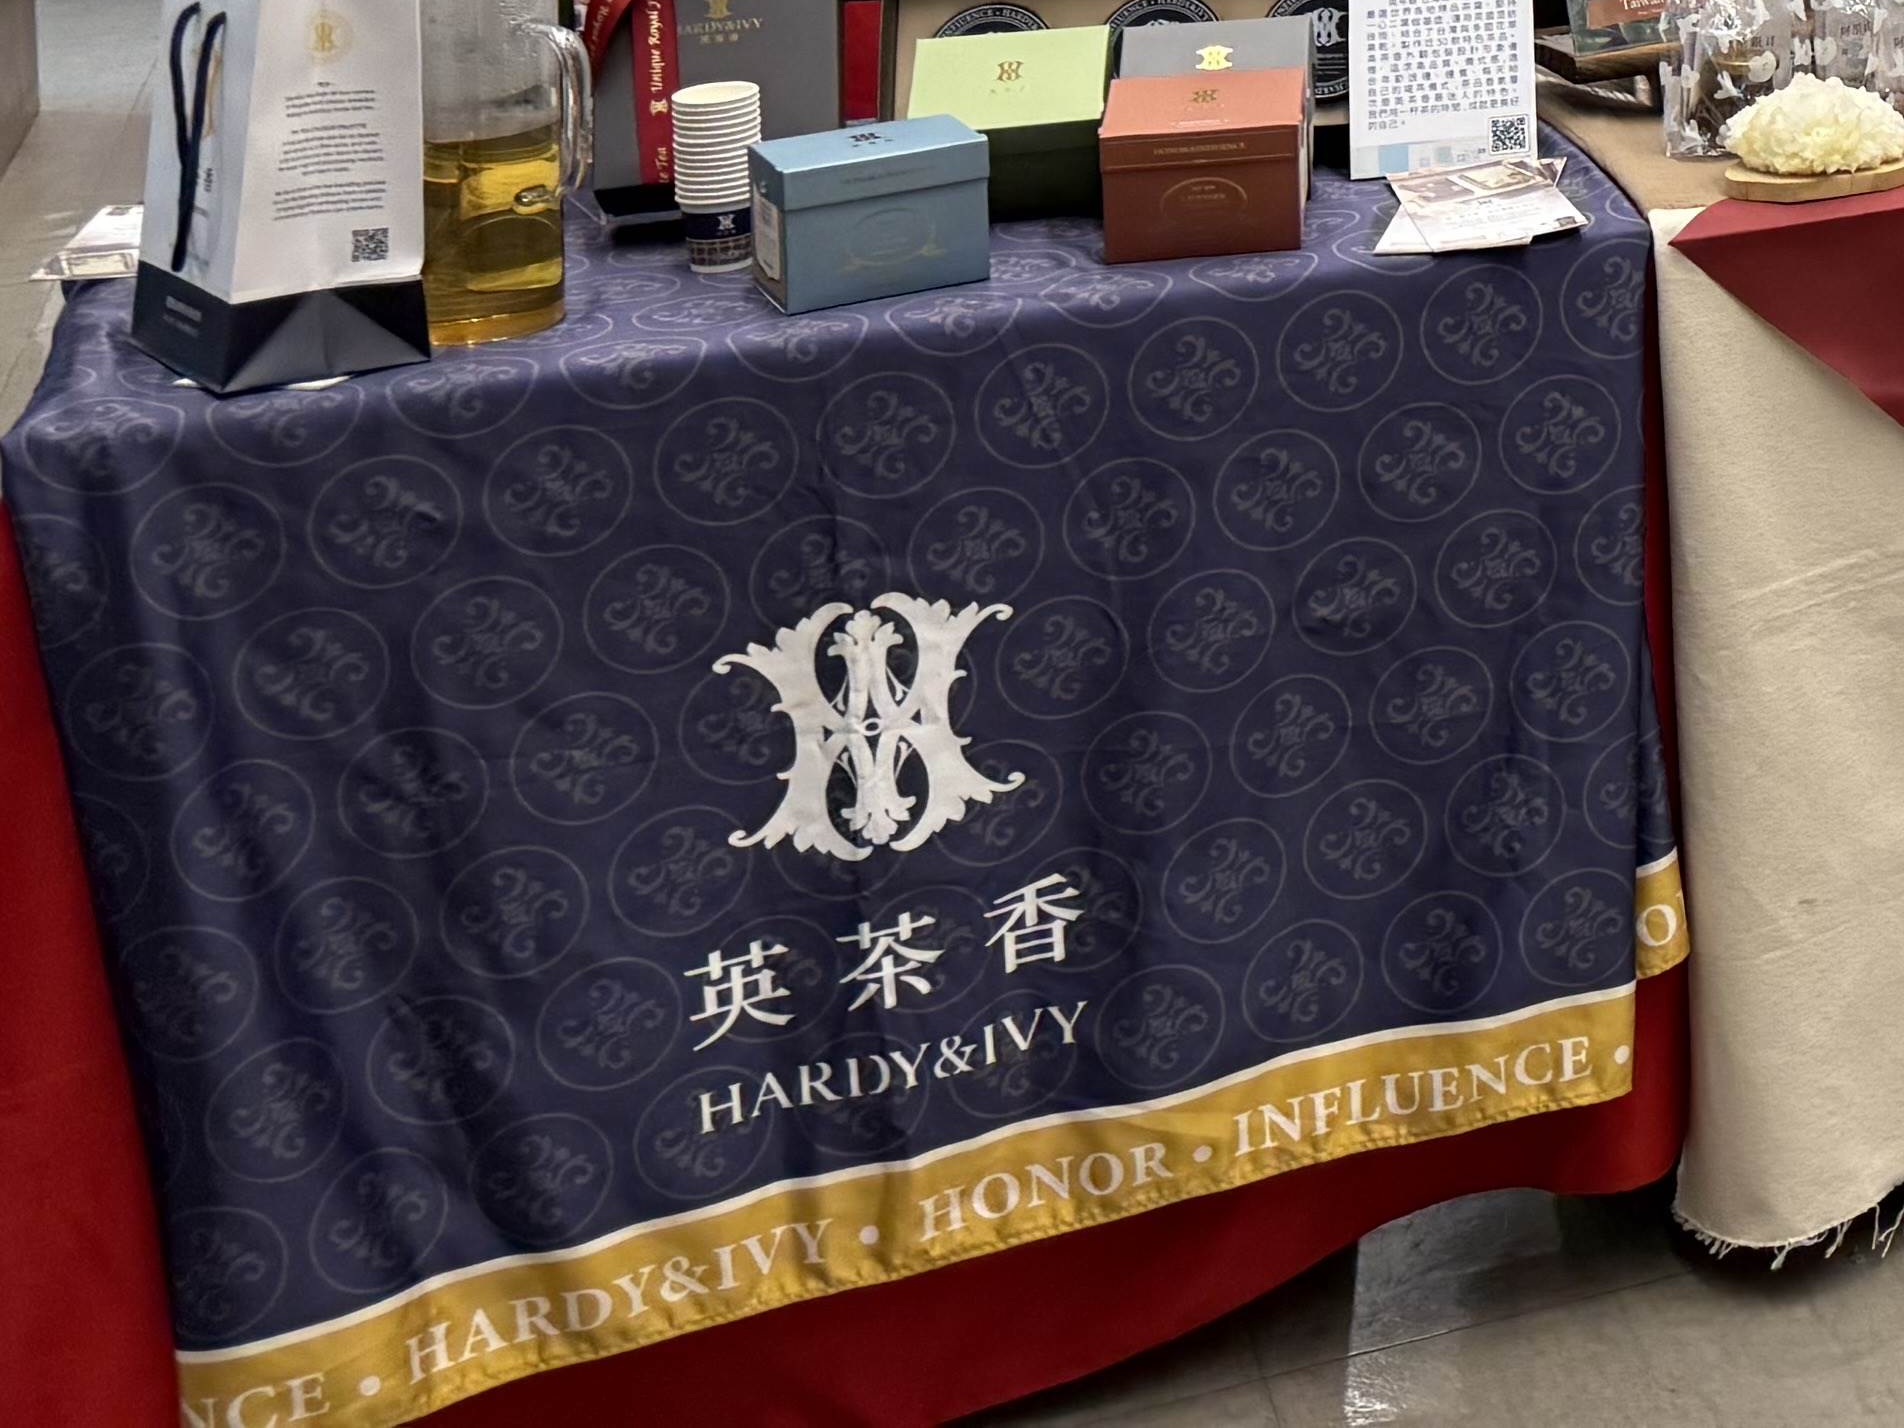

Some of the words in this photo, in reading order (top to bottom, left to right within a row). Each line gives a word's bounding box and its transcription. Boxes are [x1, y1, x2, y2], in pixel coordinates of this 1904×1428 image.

[647, 11, 663, 45] Royal
[648, 49, 665, 93] Unique
[682, 872, 1086, 1052] 英茶香
[699, 1000, 1089, 1135] HARDY&IVY
[404, 1216, 834, 1387] HARDY&IVY
[917, 1140, 1176, 1243] HONOR
[1231, 1033, 1593, 1161] INFLUENCE
